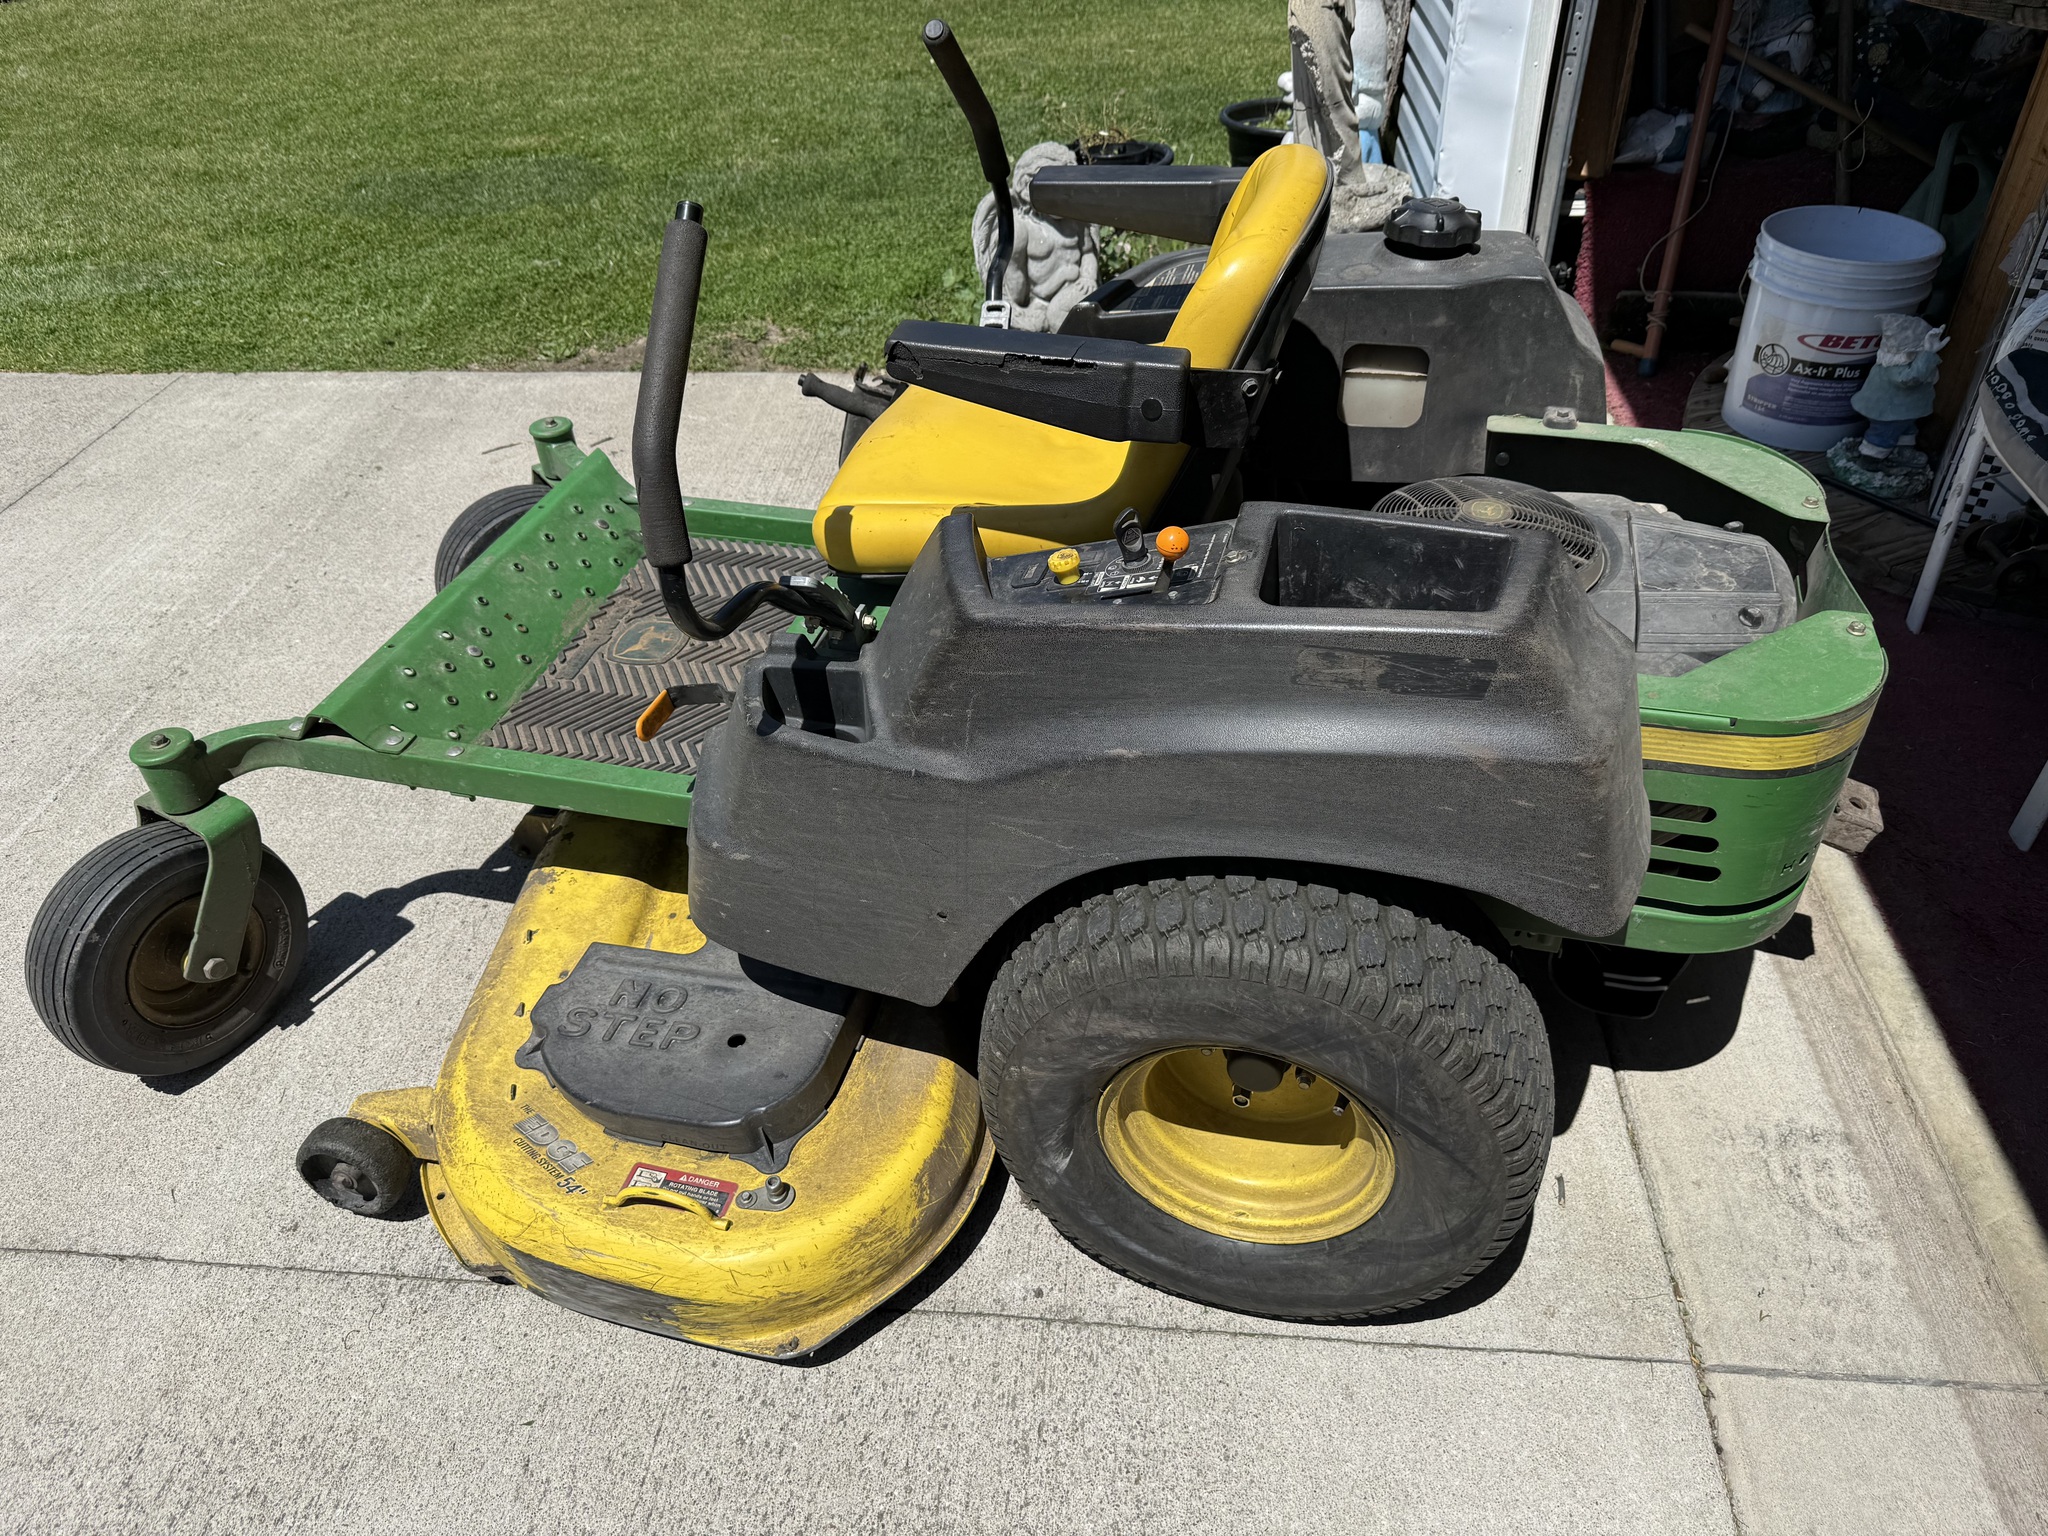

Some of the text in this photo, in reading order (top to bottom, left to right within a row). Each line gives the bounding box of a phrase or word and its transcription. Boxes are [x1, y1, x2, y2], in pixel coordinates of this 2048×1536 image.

[1834, 366, 1861, 378] Plus
[1746, 394, 1777, 409] STRIPPER
[608, 978, 689, 1014] NO
[557, 1006, 701, 1050] STEP
[520, 1104, 535, 1115] THE
[513, 1112, 594, 1175] EDGE
[513, 1137, 589, 1195] CUTTING SYSTEM 54"
[669, 1182, 719, 1197] ROTATING BLADE
[688, 1176, 720, 1188] DANGER
[687, 1191, 702, 1199] hands
